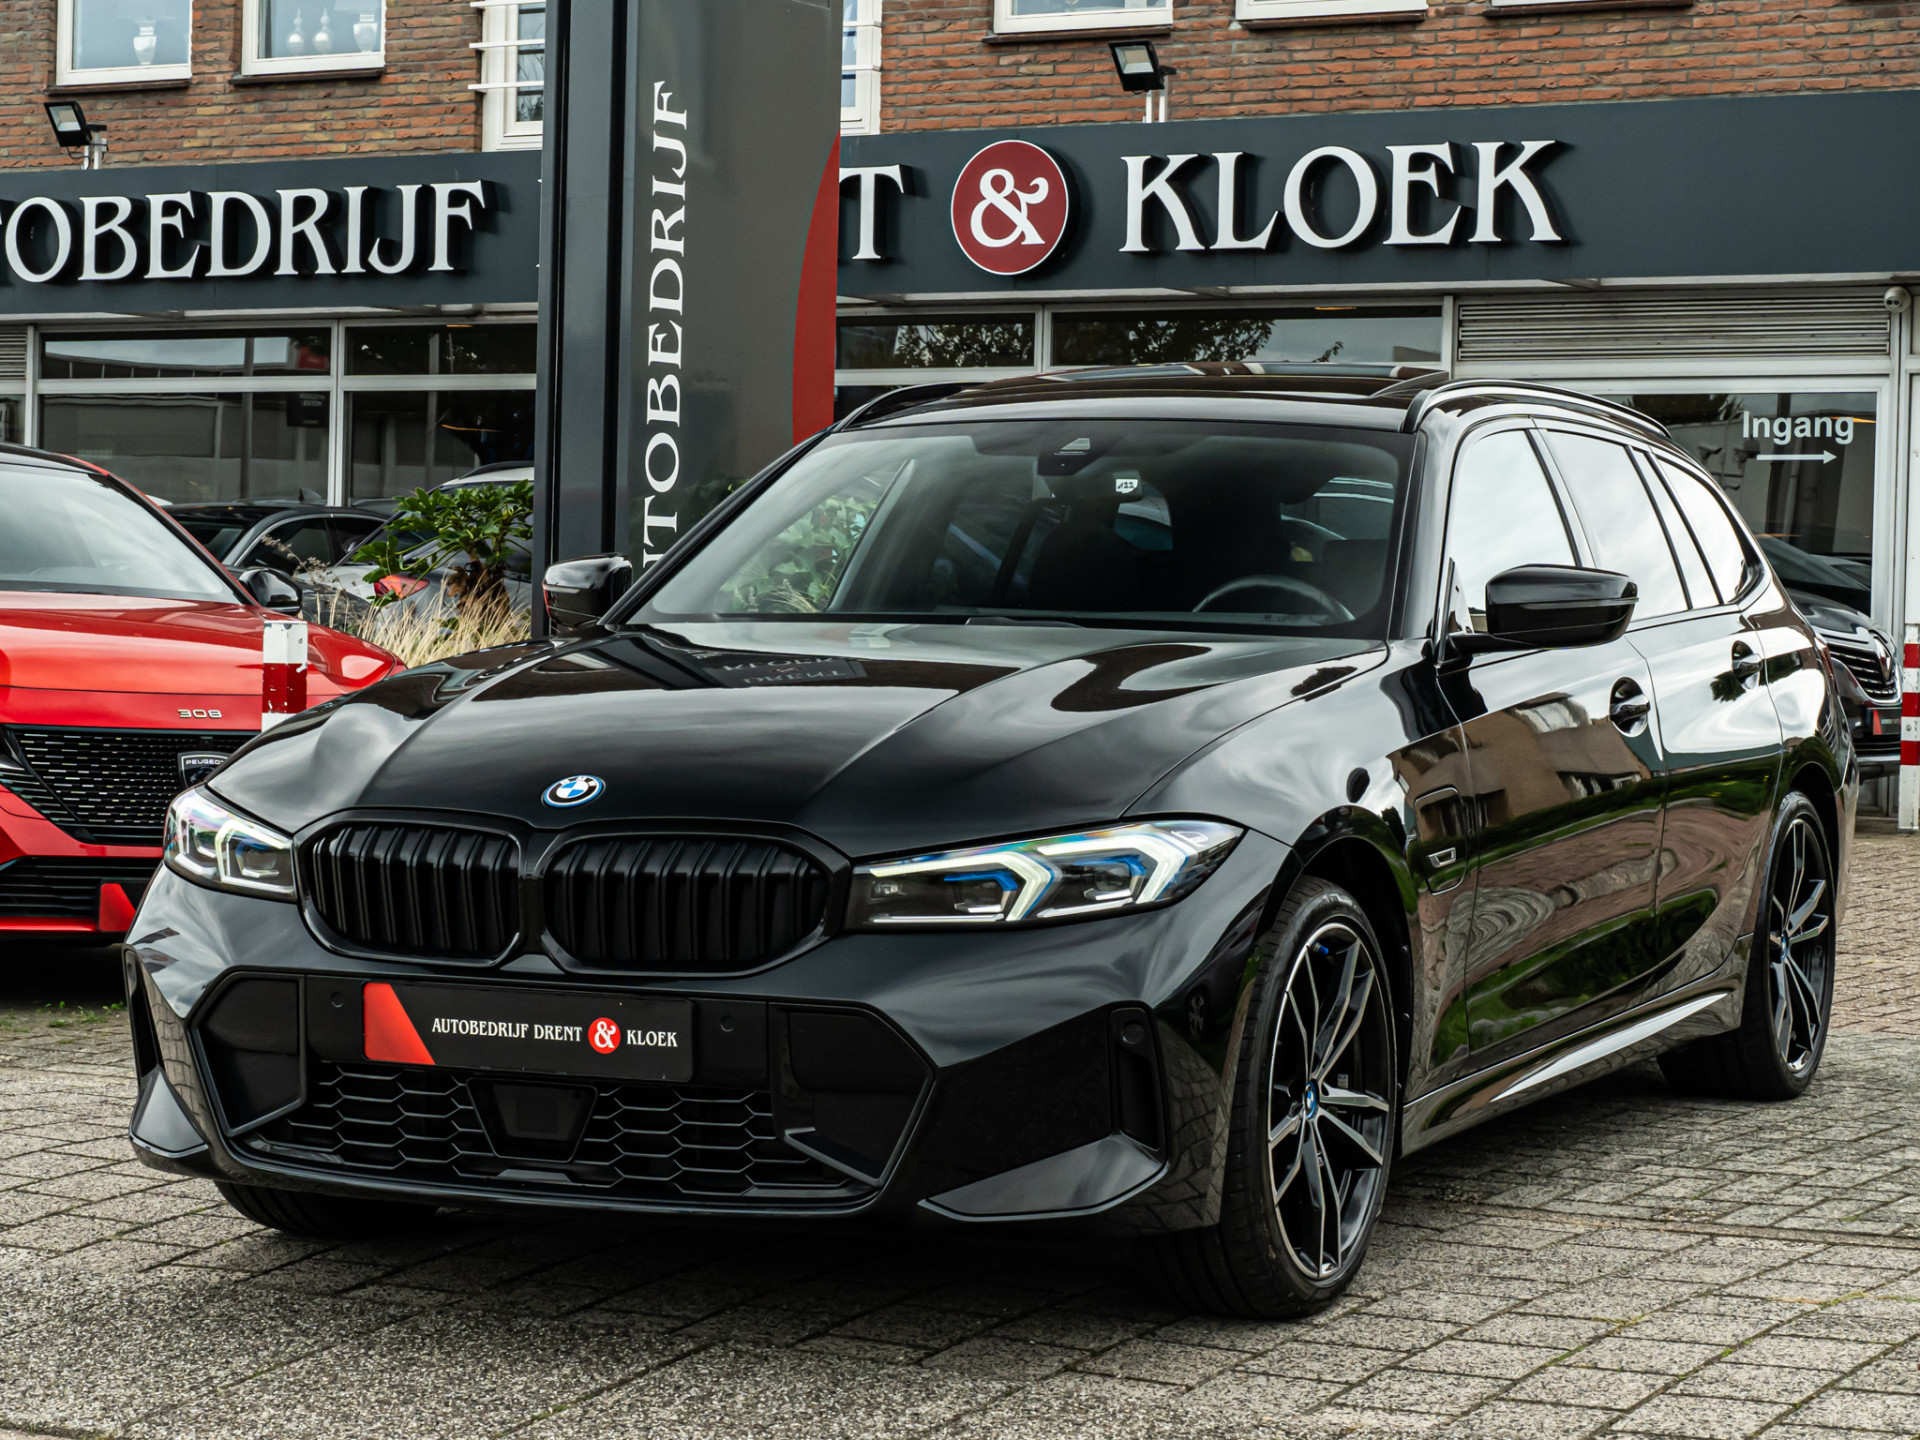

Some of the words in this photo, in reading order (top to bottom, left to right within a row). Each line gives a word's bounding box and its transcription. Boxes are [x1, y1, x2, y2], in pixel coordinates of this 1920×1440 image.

[0, 179, 485, 283] OBEDRIJF
[838, 164, 904, 260] T
[969, 167, 1049, 247] &
[1118, 140, 1562, 252] KLOEK
[1743, 410, 1854, 445] Ingang
[177, 709, 222, 718] 308
[431, 1017, 529, 1039] AUTOBEDRIJF
[533, 1023, 583, 1043] DRENT
[594, 1021, 617, 1049] &
[626, 1029, 678, 1048] KLOEK
